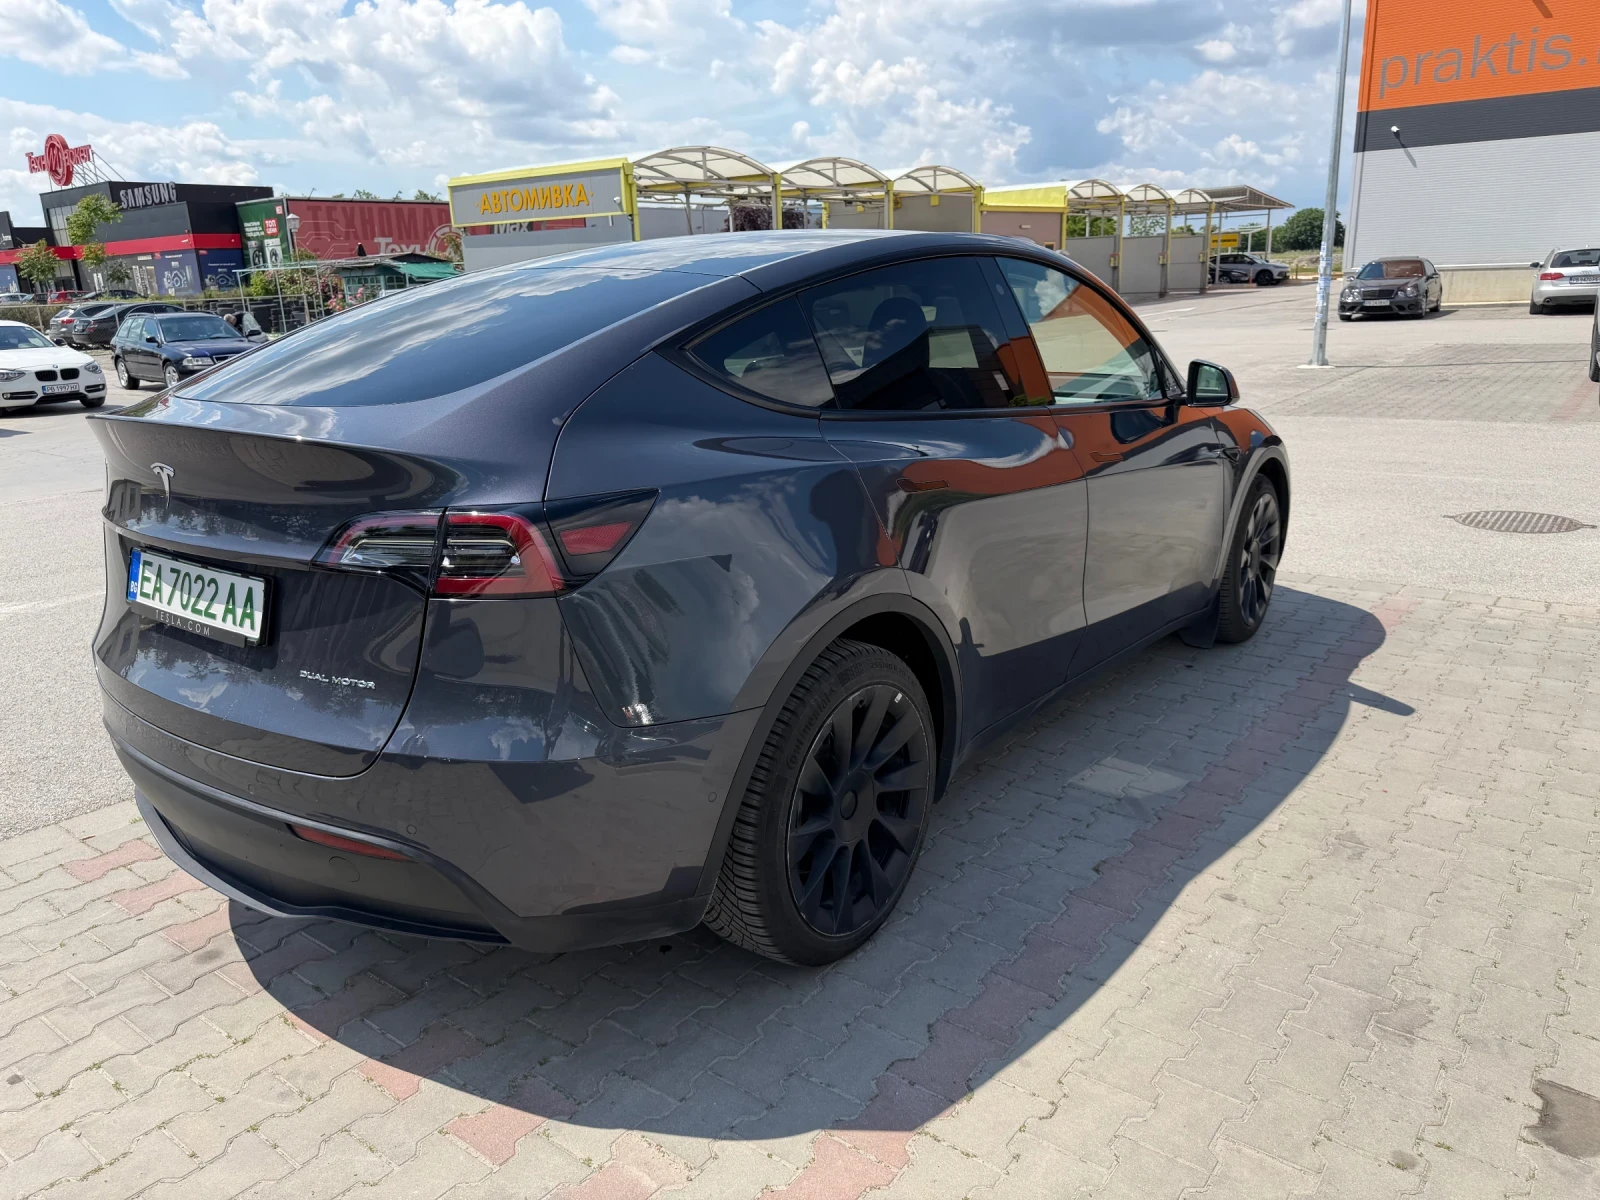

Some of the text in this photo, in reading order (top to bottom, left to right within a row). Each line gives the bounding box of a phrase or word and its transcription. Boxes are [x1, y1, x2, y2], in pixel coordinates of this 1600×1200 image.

[1379, 26, 1600, 99] praktis.
[120, 181, 177, 209] SAMSUNG
[480, 183, 590, 215] АВТОМИВКА
[130, 581, 138, 593] BG
[140, 560, 256, 632] EA 7022 AA
[155, 609, 211, 635] TESLA.COM
[299, 669, 376, 690] DUAL MOTOR
